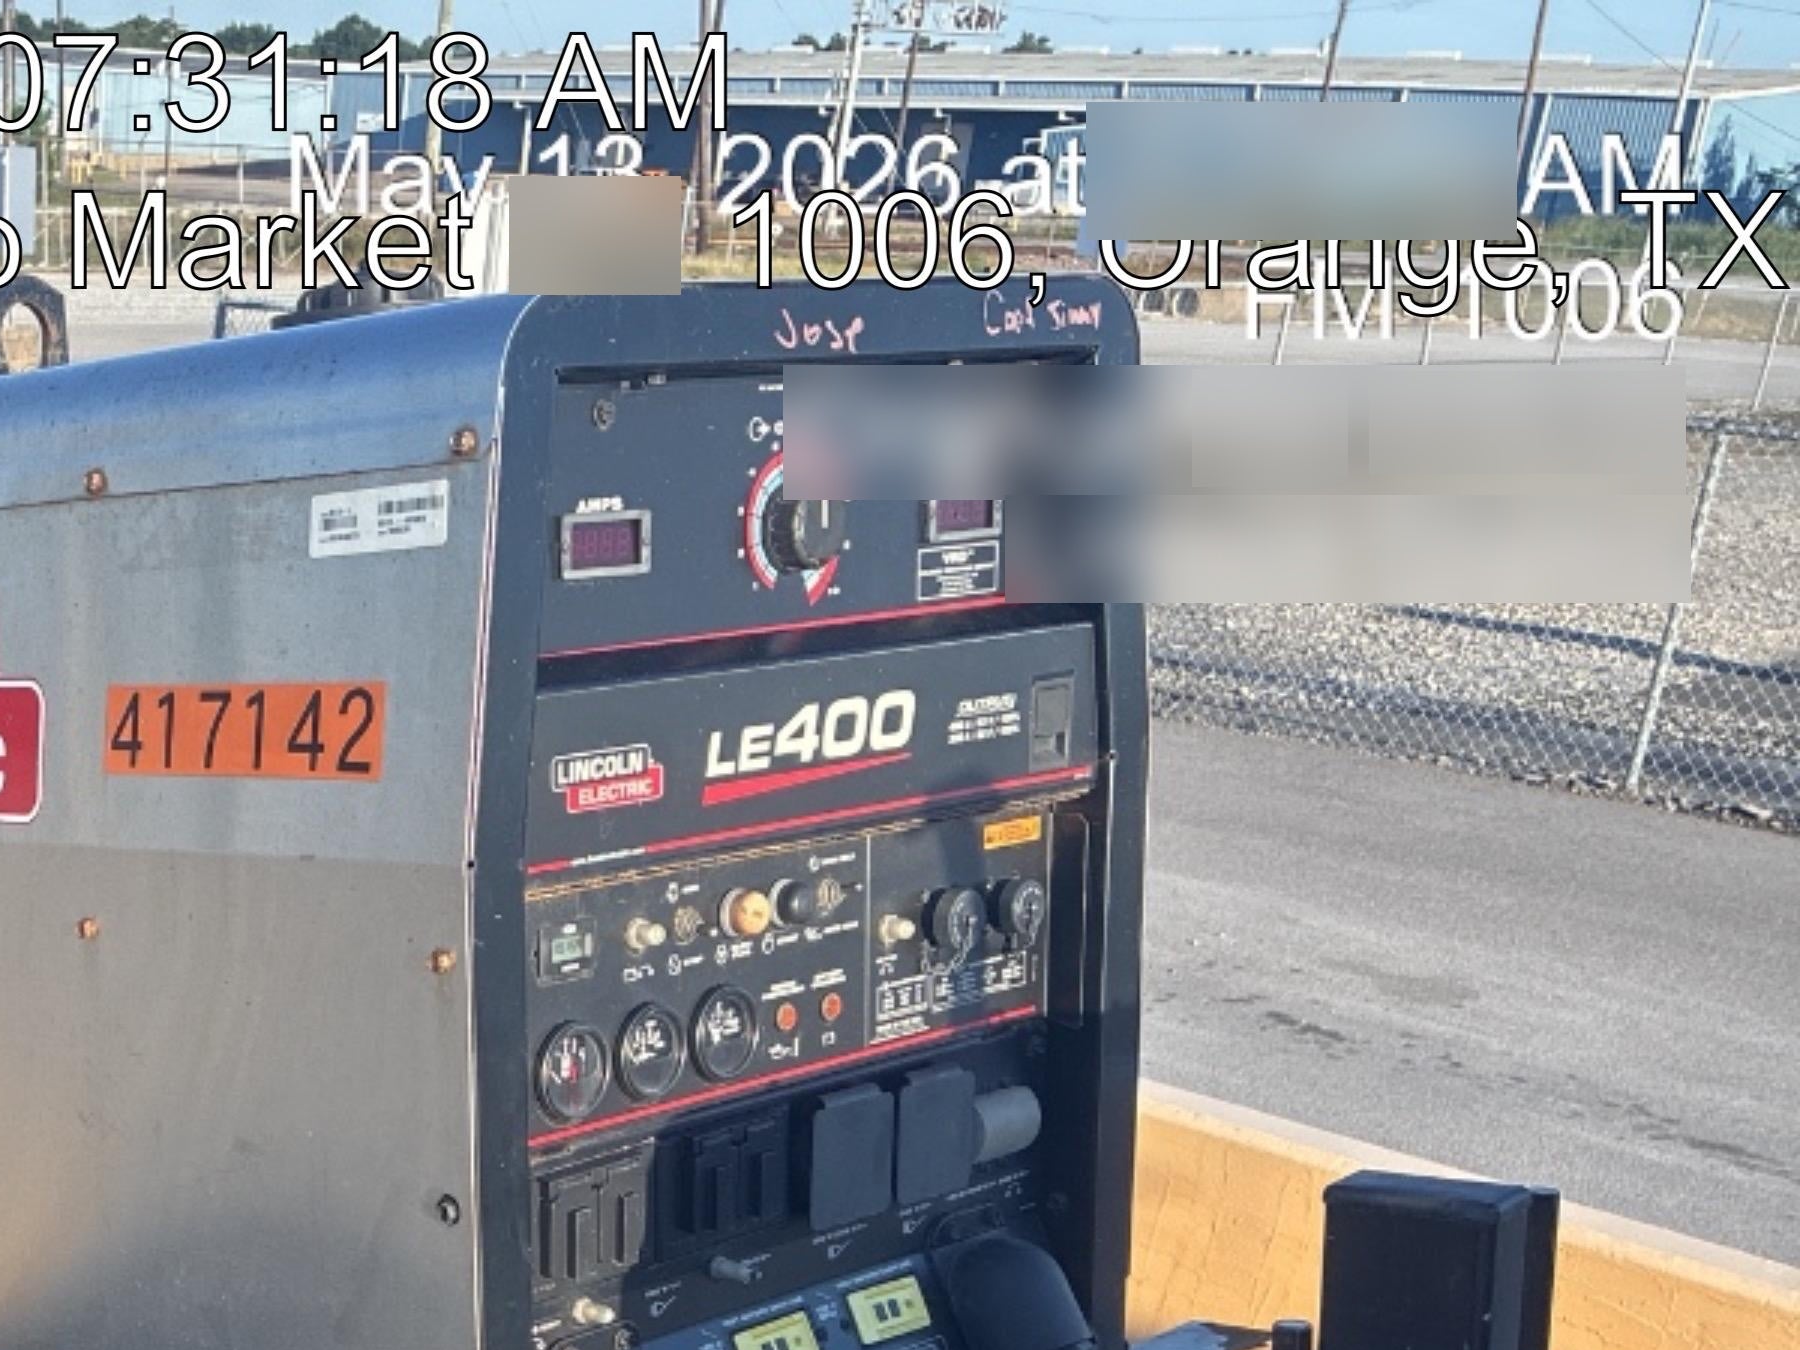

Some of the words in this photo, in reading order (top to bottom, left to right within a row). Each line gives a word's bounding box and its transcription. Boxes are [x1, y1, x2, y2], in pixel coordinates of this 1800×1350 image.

[110, 686, 376, 774] 417142
[704, 689, 916, 778] LE400
[556, 749, 644, 785] LINCOLN
[578, 778, 654, 806] ELECTRIC
